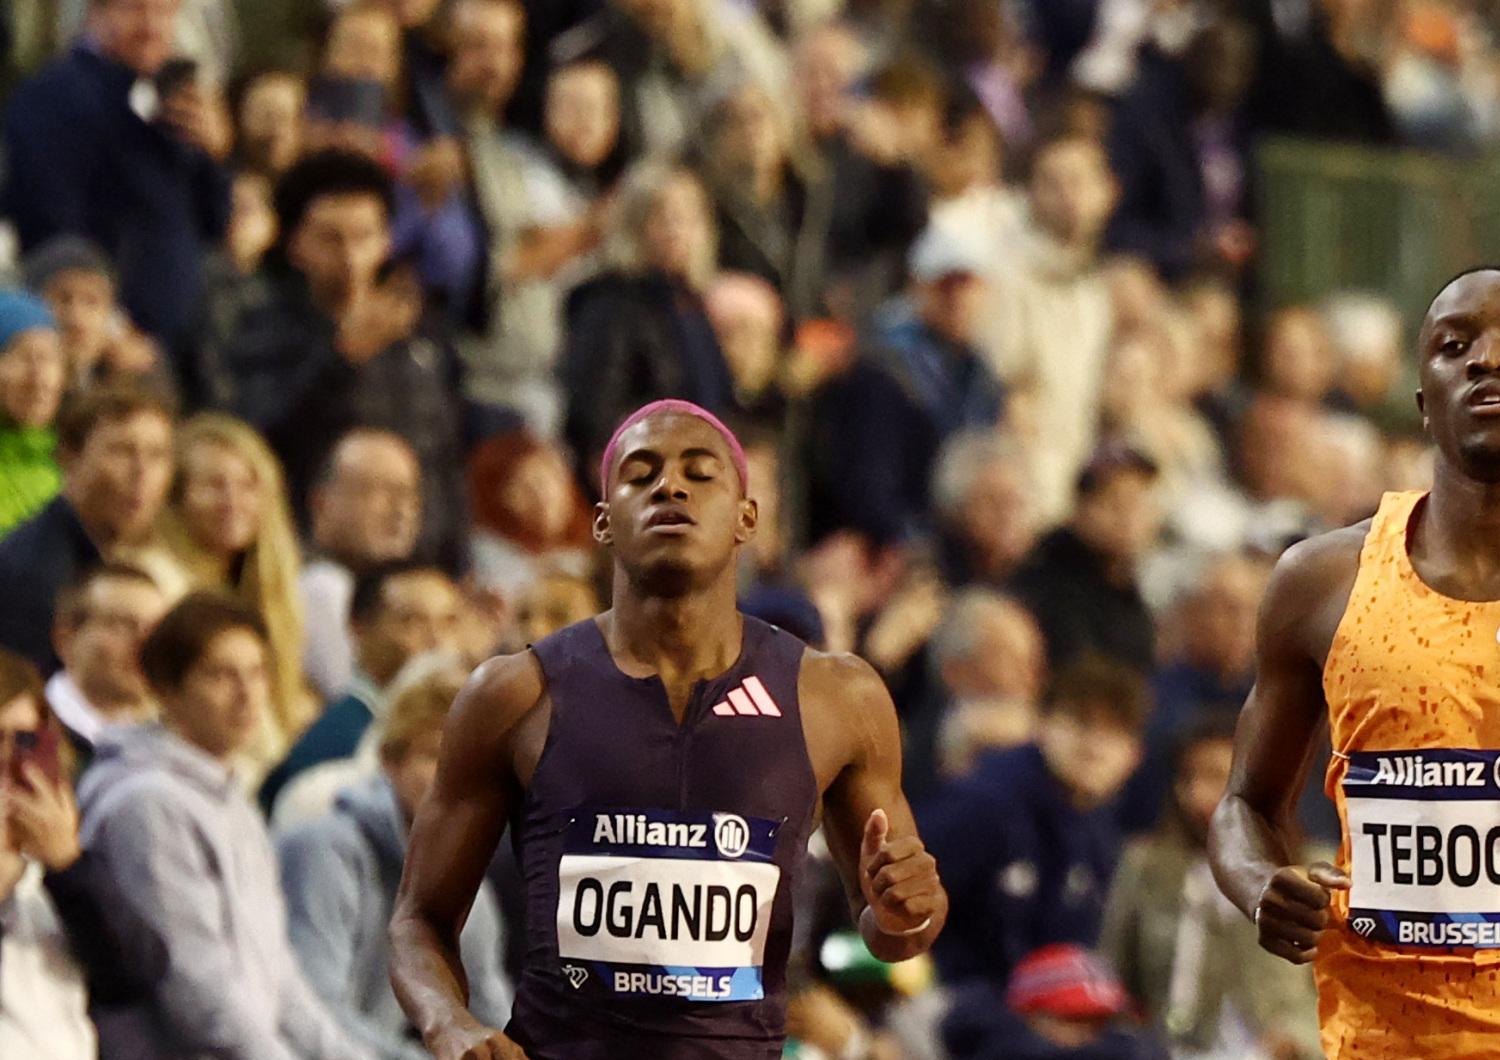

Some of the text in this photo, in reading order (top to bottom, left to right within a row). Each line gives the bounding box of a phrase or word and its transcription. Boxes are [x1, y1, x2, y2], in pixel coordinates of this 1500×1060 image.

[1371, 756, 1486, 787] Allianz
[593, 814, 707, 847] Allianz
[573, 877, 758, 942] OGANDO
[614, 971, 731, 997] BRUSSELS
